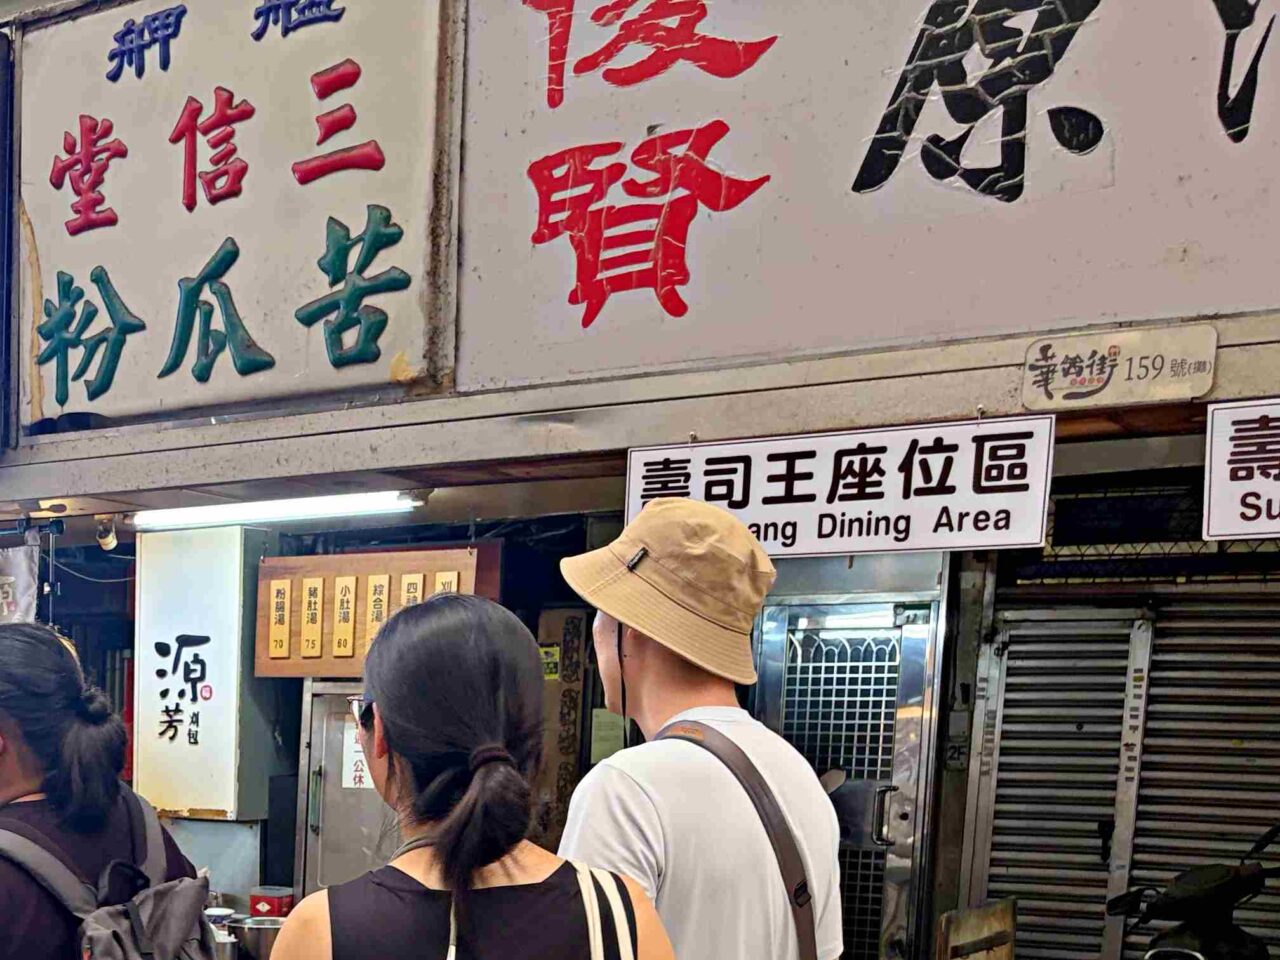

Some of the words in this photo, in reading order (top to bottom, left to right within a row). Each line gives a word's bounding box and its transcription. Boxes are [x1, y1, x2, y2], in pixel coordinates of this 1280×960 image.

[50, 58, 386, 236] 三信堂
[37, 204, 412, 406] 苦瓜粉
[1124, 354, 1165, 382] 159
[640, 430, 1036, 510] 壽司王座位區
[748, 517, 798, 548] ang
[817, 510, 912, 543] Dining
[932, 505, 1012, 534] Area
[273, 638, 284, 650] 70
[305, 638, 317, 650] 75
[336, 637, 348, 649] 60
[154, 634, 212, 742] 源芳
[187, 710, 201, 746] 刈包
[947, 744, 968, 761] 2F
